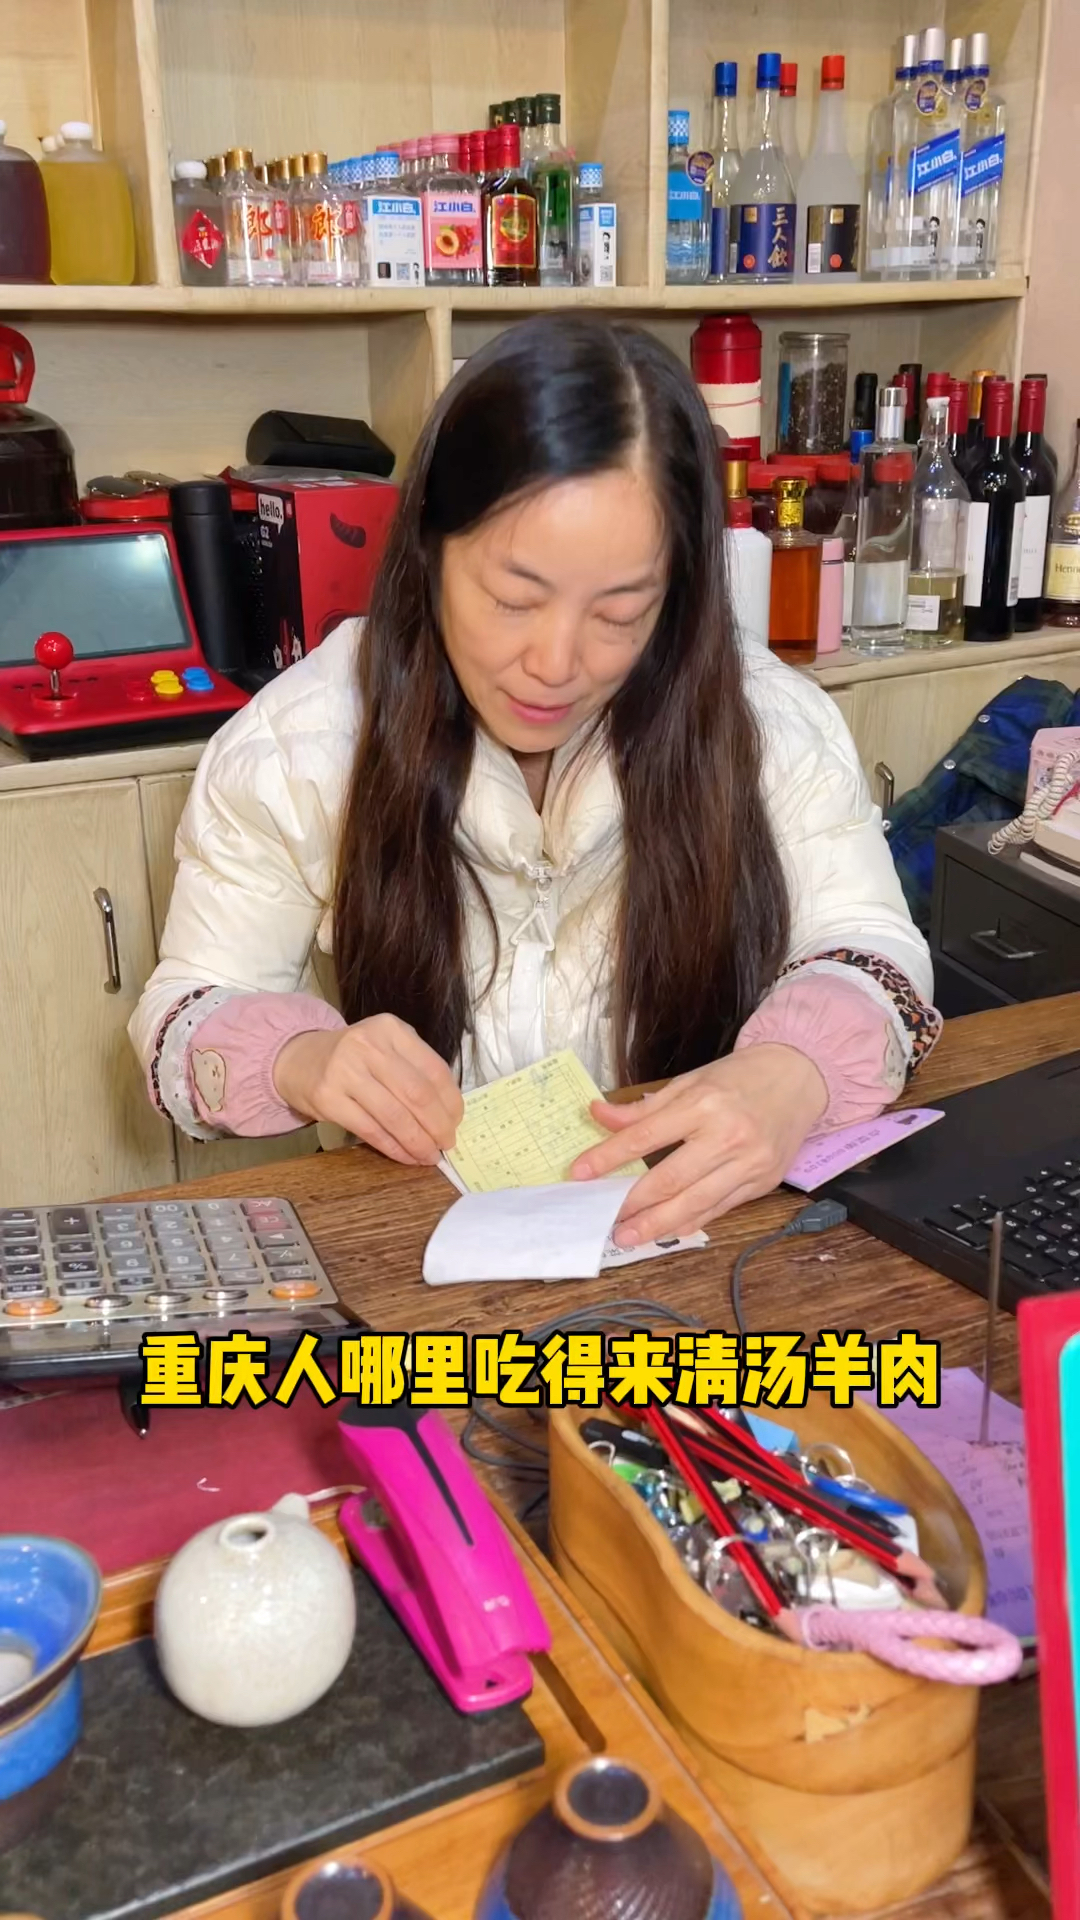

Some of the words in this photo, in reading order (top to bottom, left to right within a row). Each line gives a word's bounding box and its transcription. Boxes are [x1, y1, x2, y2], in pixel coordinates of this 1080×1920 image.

[917, 149, 957, 178] 江小白
[964, 153, 1003, 180] 江小白
[378, 201, 416, 213] 江小白
[434, 201, 476, 213] 江小白
